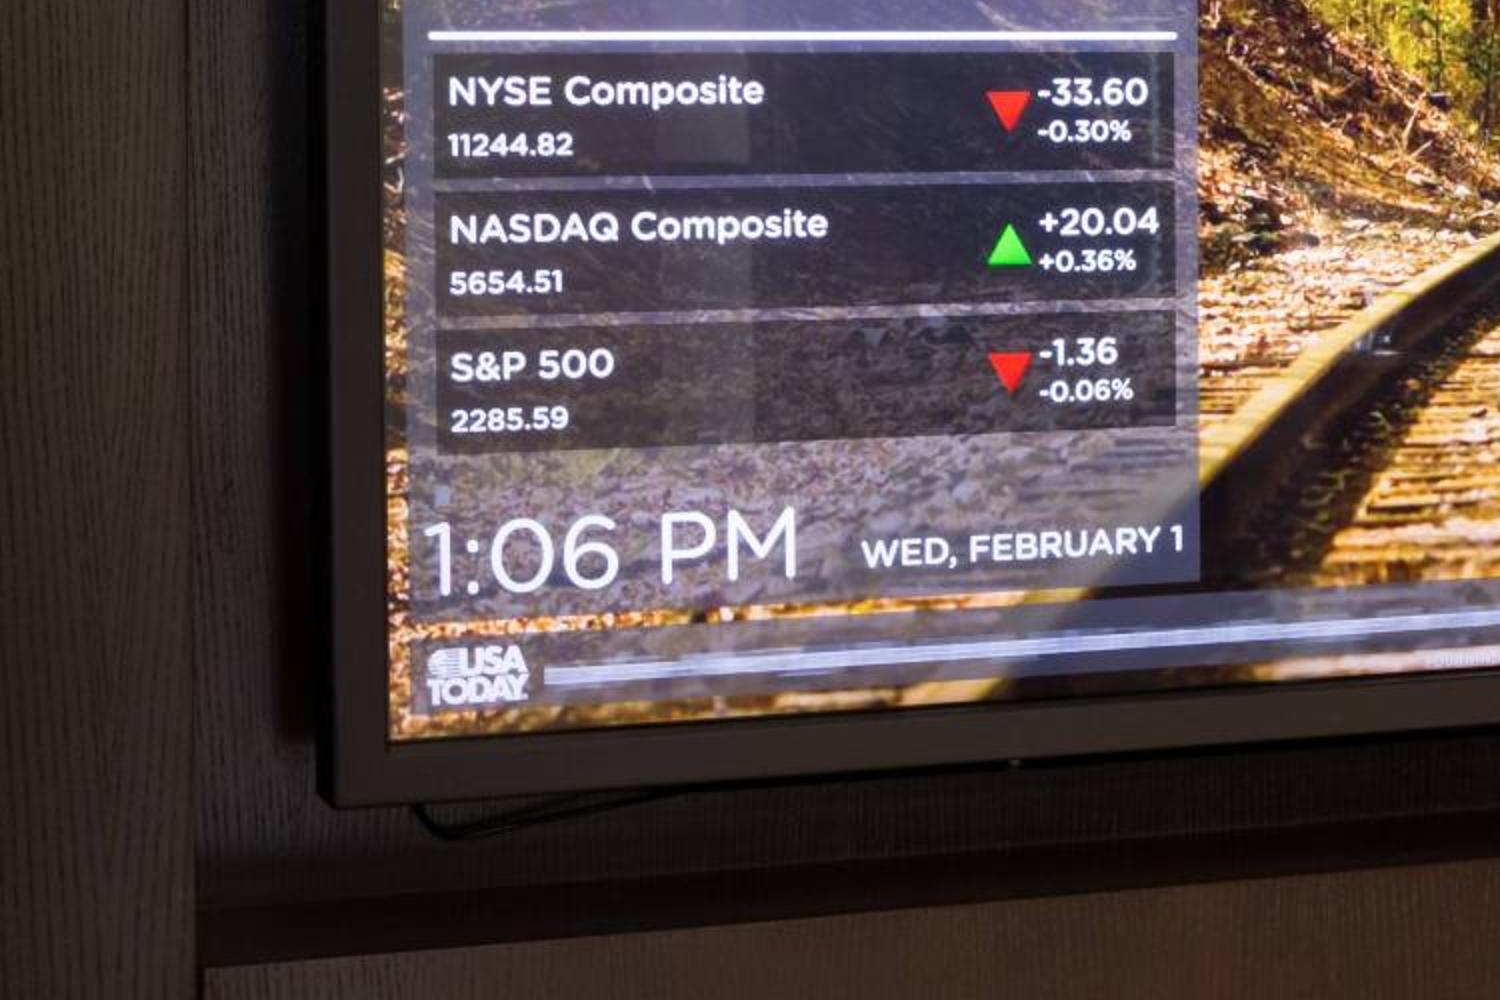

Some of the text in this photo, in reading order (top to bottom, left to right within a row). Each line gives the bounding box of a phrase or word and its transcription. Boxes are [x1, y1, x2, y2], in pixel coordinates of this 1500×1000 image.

[450, 75, 764, 110] NYSE Composite
[1038, 78, 1148, 106] -33.60
[448, 133, 573, 156] 11244.82
[1038, 120, 1132, 142] -0.30%
[451, 209, 828, 245] NASDAQ Composite
[1040, 207, 1159, 235] +20.04
[1039, 249, 1136, 272] +0.36%
[450, 270, 562, 295] 5654.51
[451, 349, 614, 381] S&P 500
[1040, 337, 1118, 366] -1.36
[1040, 378, 1133, 402] -0.06%
[452, 406, 568, 432] 2285.59
[425, 506, 796, 595] 1:06 PM
[861, 525, 1182, 568] WED, FEBRUARY 1
